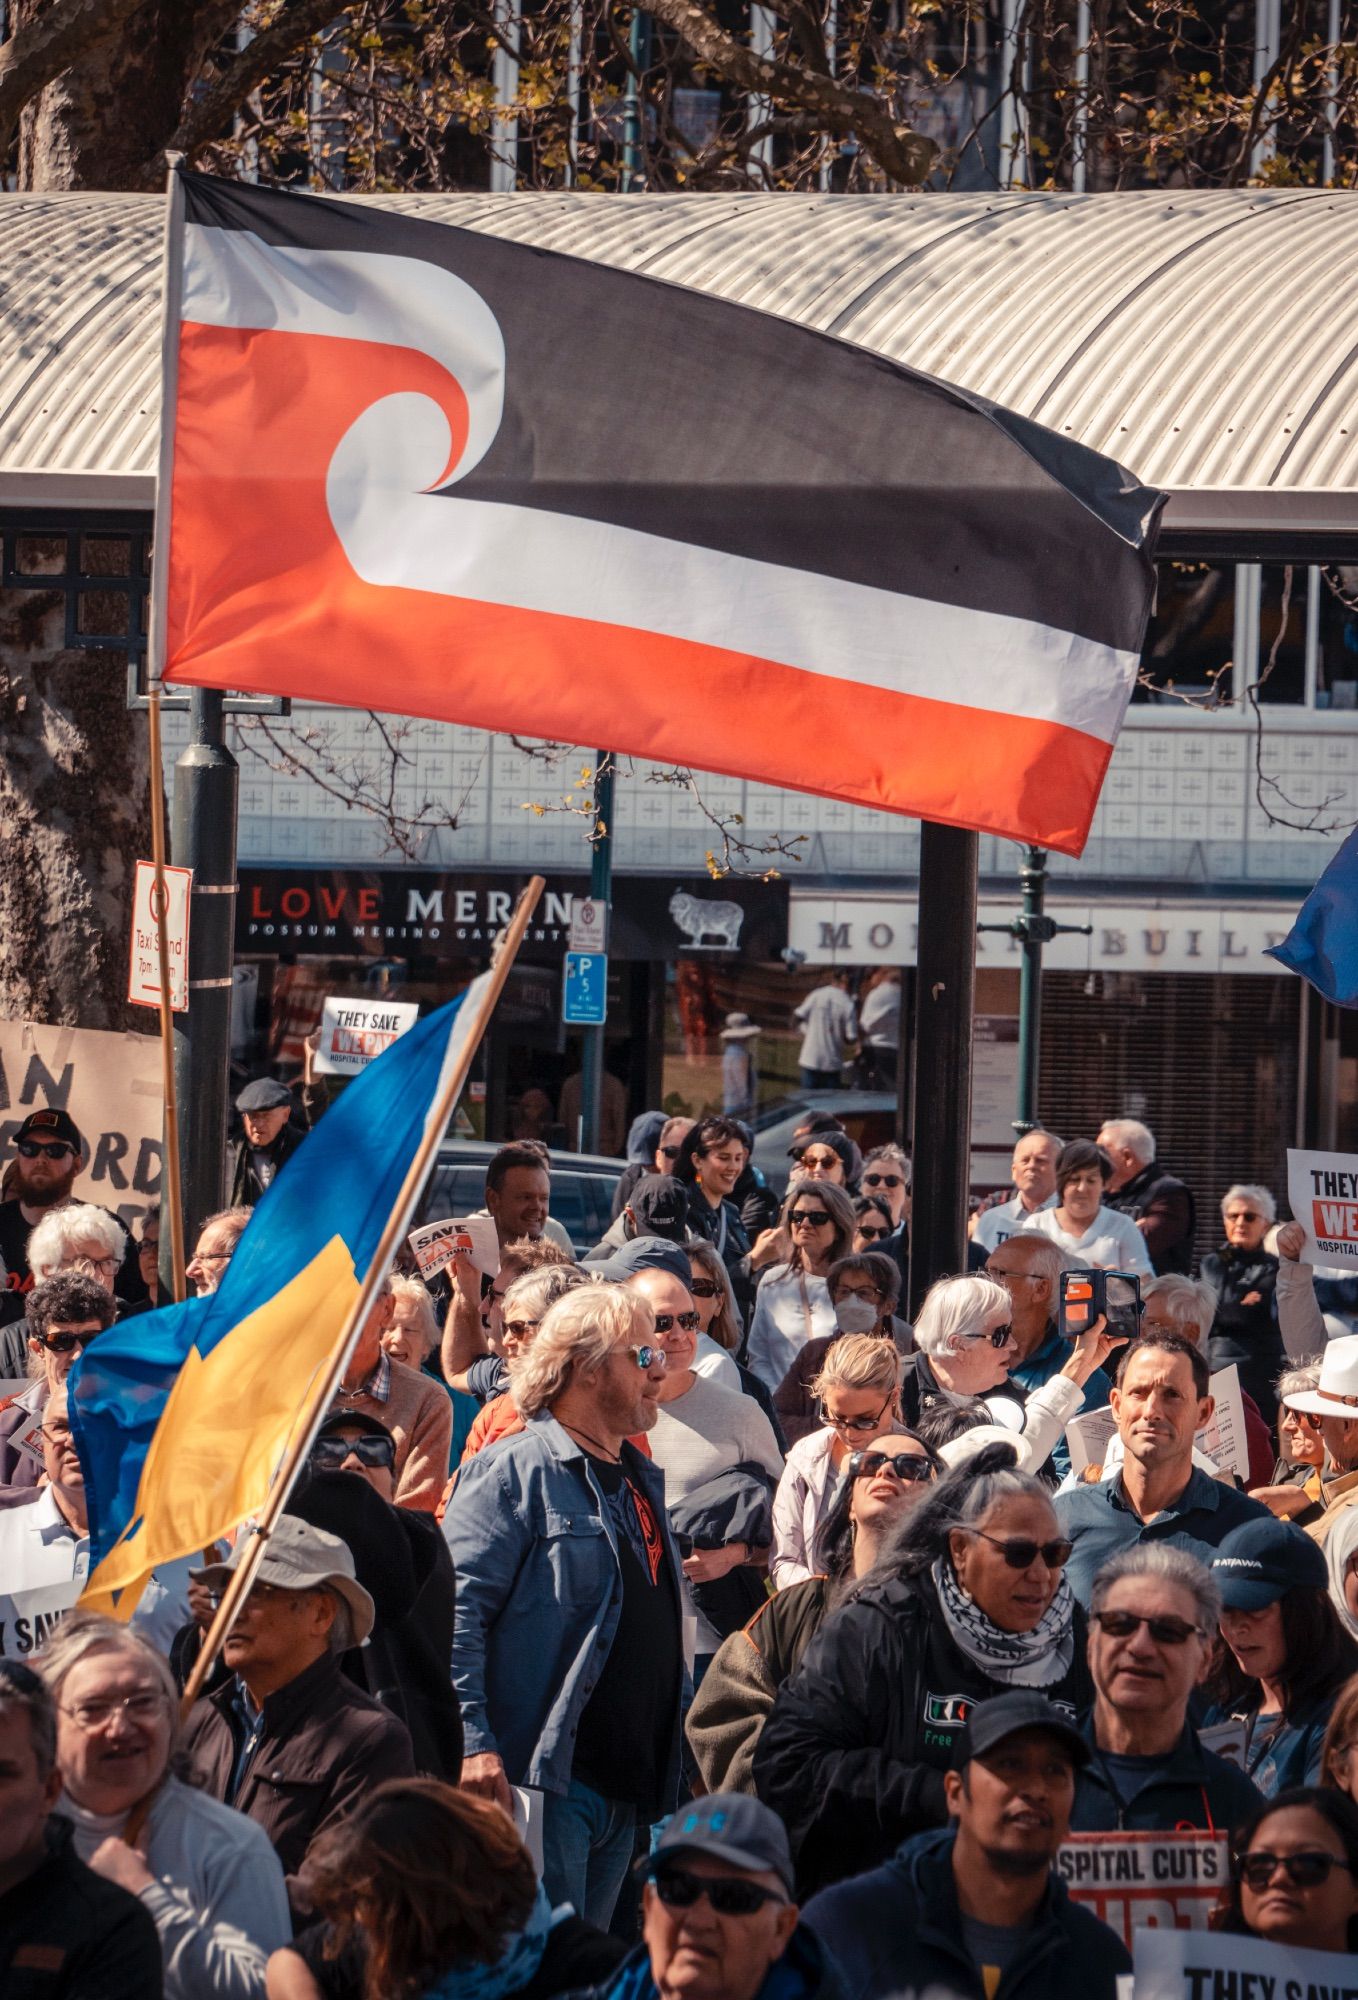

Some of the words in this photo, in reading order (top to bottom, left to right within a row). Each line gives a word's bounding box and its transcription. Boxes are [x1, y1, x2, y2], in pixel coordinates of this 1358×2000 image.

[252, 887, 381, 921] LOVE
[405, 889, 612, 925] MERN
[136, 929, 152, 950] Taxi
[154, 933, 182, 955] Snd
[249, 924, 337, 937] POSSUM
[353, 925, 440, 940] MERINO
[579, 957, 592, 977] P
[337, 1010, 369, 1028] THEY
[370, 1014, 401, 1031] SAVE
[338, 1030, 362, 1054] WE
[330, 1053, 359, 1065] HOSPITAL
[1310, 1169, 1358, 1199] THEY
[1320, 1203, 1358, 1238] WE
[417, 1224, 470, 1249] SAVE
[1316, 1240, 1358, 1256] HOSPITAL
[416, 1235, 460, 1267] PAY
[15, 1609, 69, 1653] SAV
[924, 1729, 952, 1747] Free
[1050, 1848, 1145, 1882] SPITAL
[1152, 1847, 1218, 1880] CUTS
